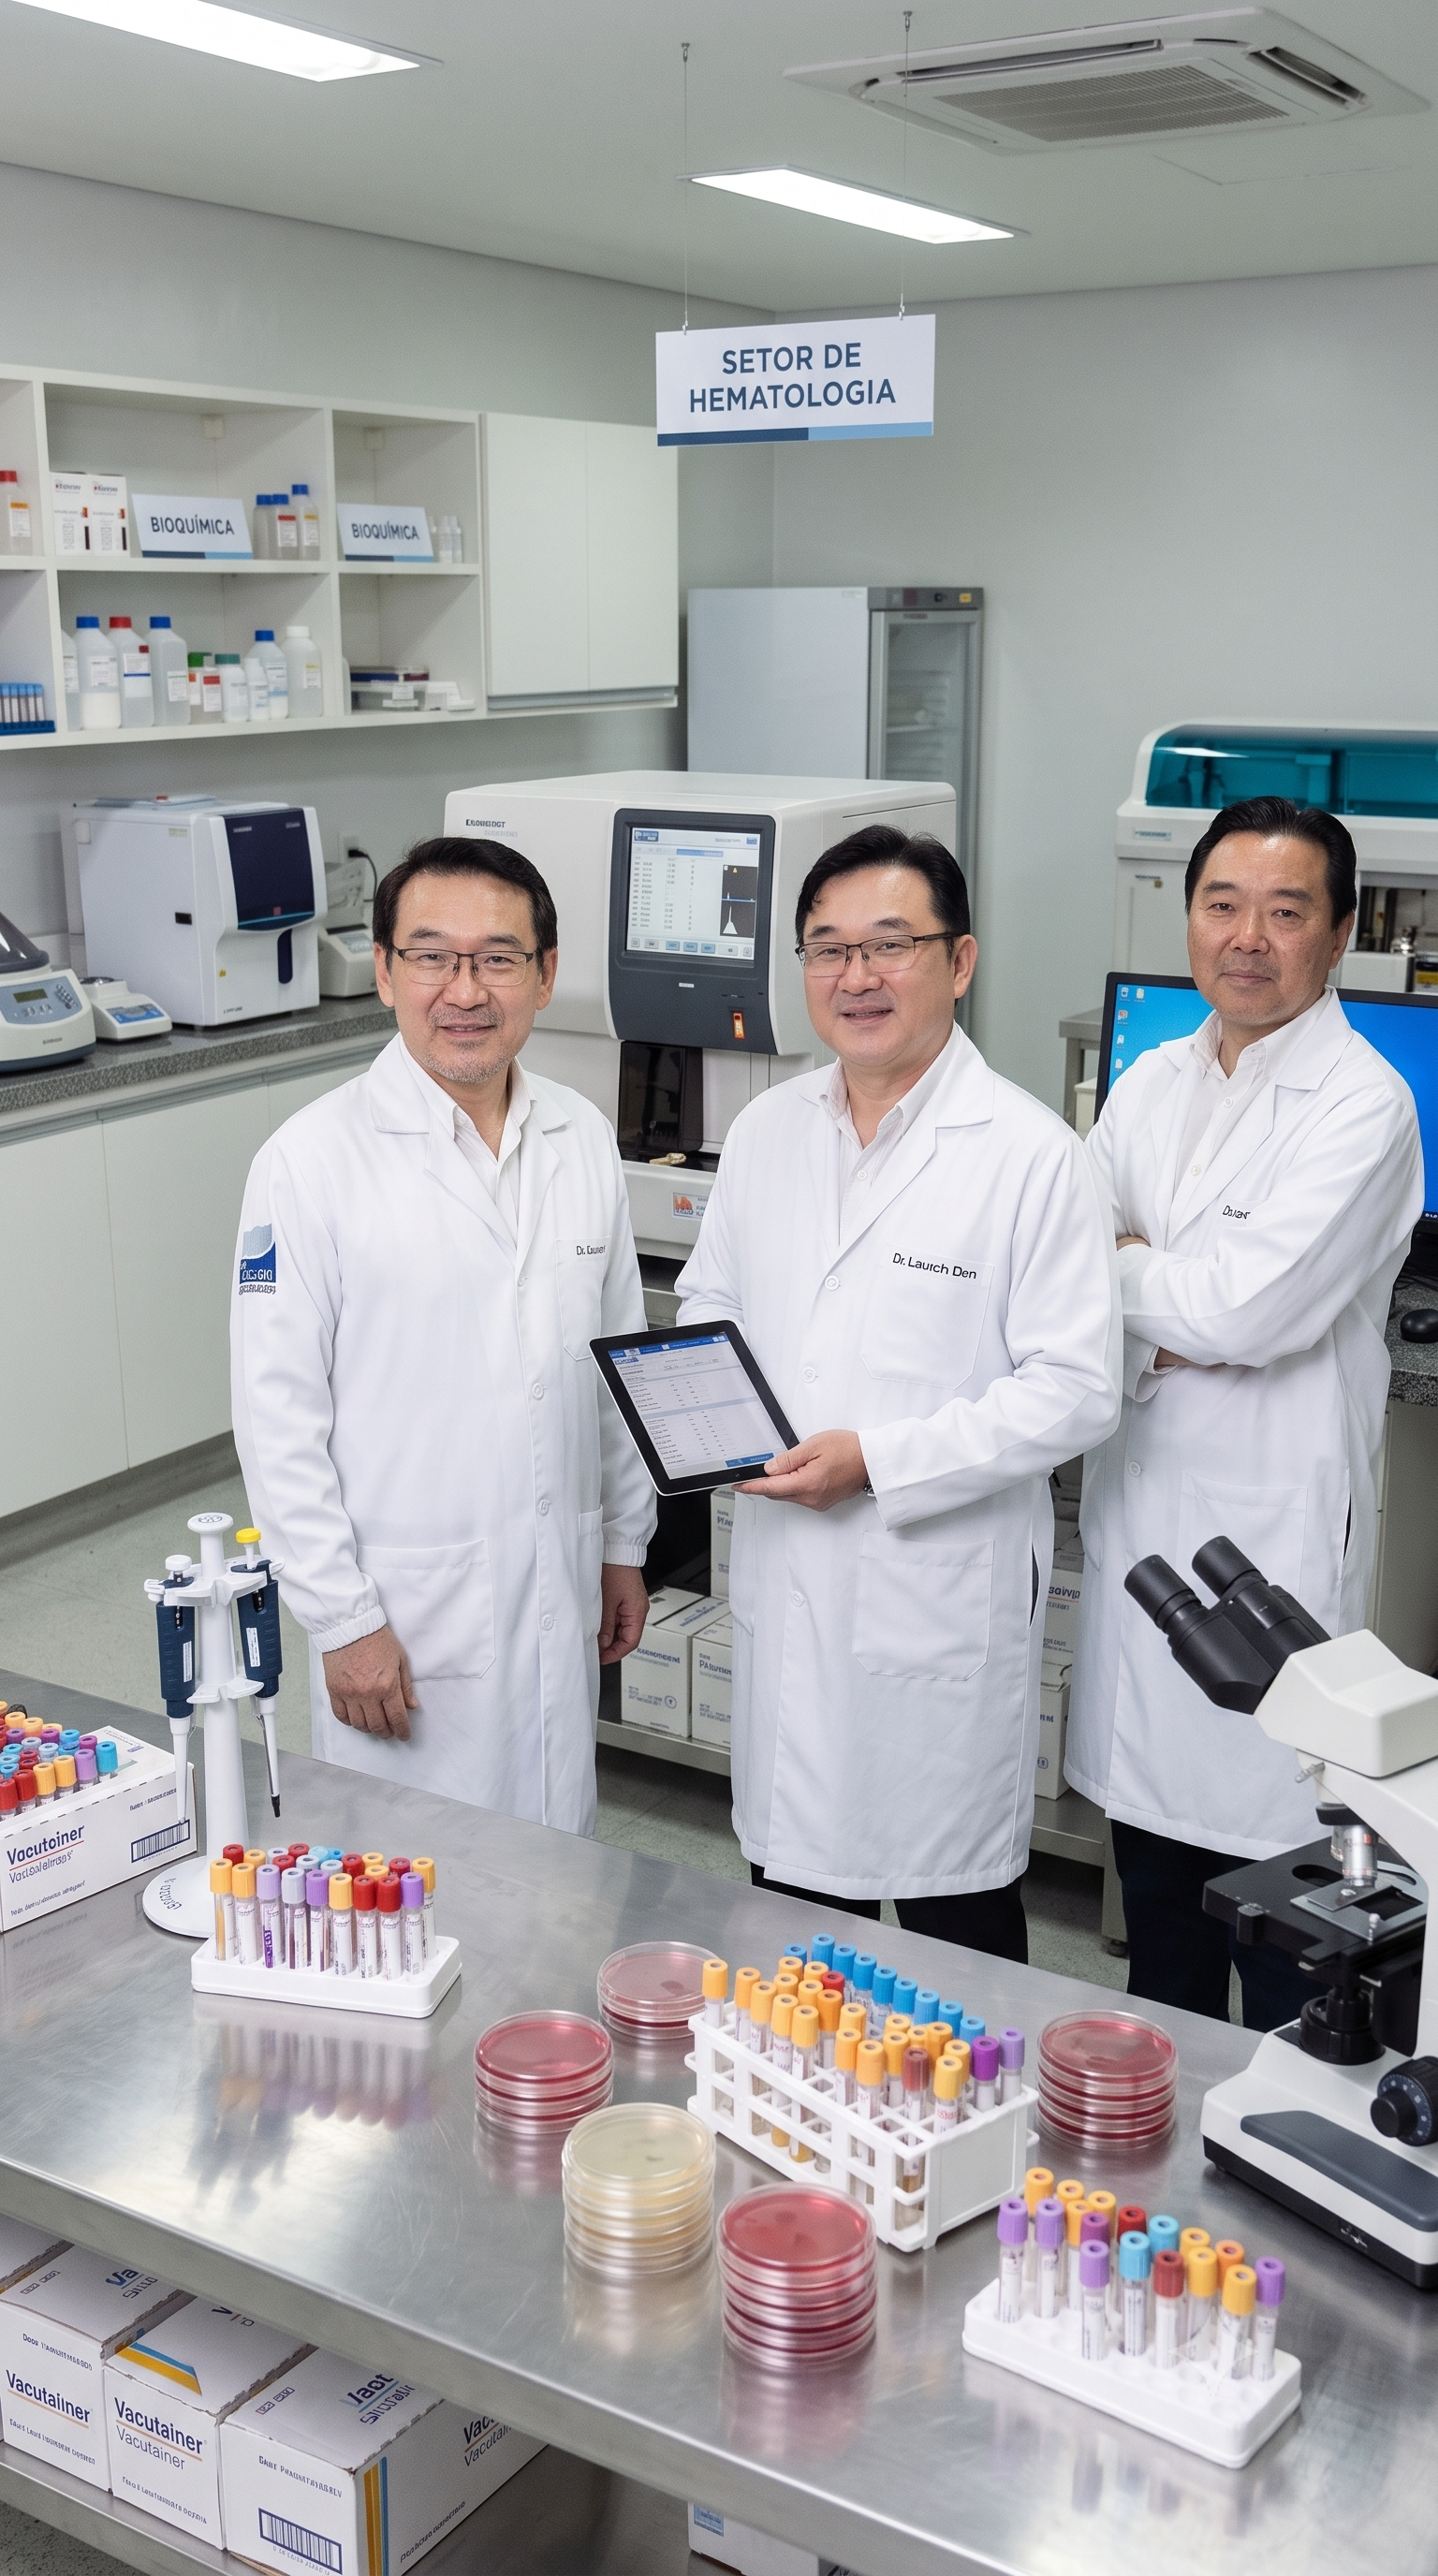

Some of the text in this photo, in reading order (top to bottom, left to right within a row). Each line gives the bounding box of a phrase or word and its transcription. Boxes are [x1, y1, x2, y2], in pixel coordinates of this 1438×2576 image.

[722, 343, 861, 374] SETOR DE
[690, 378, 897, 413] HEMATOLOGIA
[150, 514, 235, 535] BIOQUÍMICA
[351, 520, 420, 540] BIOQUÍMICA
[892, 1252, 905, 1266] Dr.
[952, 1266, 977, 1280] Den
[114, 2396, 203, 2454] Vacutainer
[116, 2424, 185, 2470] Vacutainer
